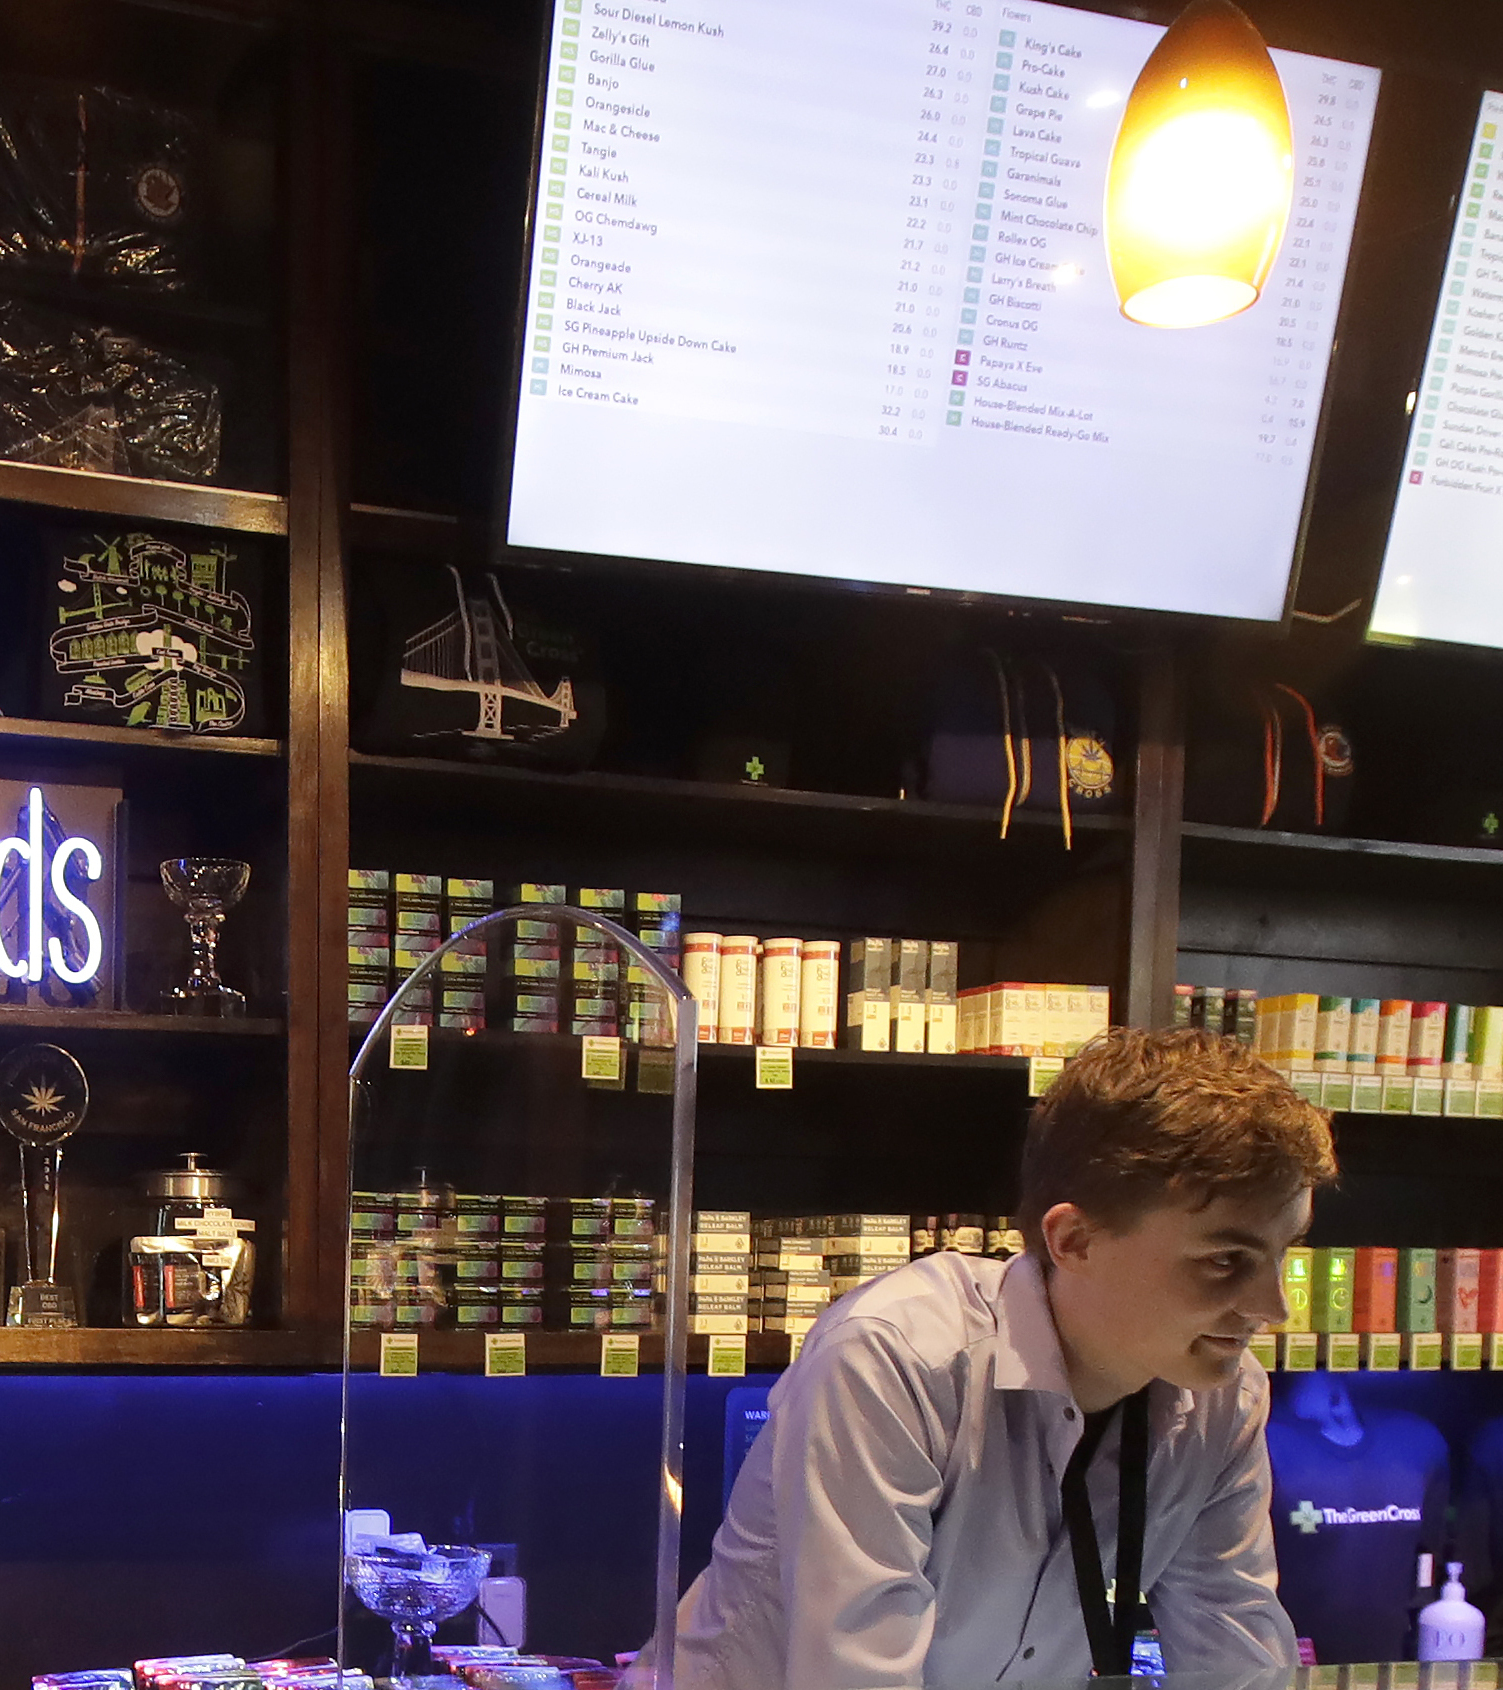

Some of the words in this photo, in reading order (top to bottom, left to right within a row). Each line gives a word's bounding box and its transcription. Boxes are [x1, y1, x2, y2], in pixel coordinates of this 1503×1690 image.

[594, 4, 619, 20] Sour
[623, 8, 655, 25] Diesel
[659, 15, 694, 32] Lemon
[698, 21, 724, 37] Kush
[630, 32, 650, 49] Gift
[1025, 37, 1055, 54] King's
[1058, 44, 1082, 58] Cake
[590, 50, 625, 67] Gorilla
[630, 56, 655, 72] Glue
[588, 74, 619, 90] Banjo
[1019, 82, 1042, 97] Kush
[1046, 87, 1069, 100] Cake
[583, 120, 606, 136] Mac
[609, 124, 618, 135] &
[621, 126, 660, 143] Cheese
[582, 142, 617, 160] Tangie
[579, 165, 600, 180] Kali
[604, 169, 629, 184] Kush
[577, 188, 611, 205] Cereal
[614, 193, 638, 207] Milk
[575, 211, 593, 223] OG
[596, 213, 658, 236] Chemdawg
[1001, 210, 1023, 224] Mint
[1026, 214, 1073, 232] Chocolate
[1076, 222, 1098, 237] Chip
[1030, 237, 1046, 248] OG
[570, 255, 632, 276] Orangeade
[569, 278, 604, 295] Cherry
[607, 282, 623, 295] AK
[567, 299, 594, 313] Black
[598, 302, 621, 316] Jack
[582, 323, 635, 343] Pineapple
[639, 330, 675, 348] Upside
[678, 335, 709, 350] Down
[711, 339, 737, 353] Cake
[563, 343, 579, 355] GH
[582, 345, 627, 361] Premium
[631, 350, 654, 364] Jack
[560, 365, 602, 379] Mimosa
[558, 386, 573, 397] Ice
[576, 388, 609, 402] Cream
[613, 393, 638, 405] Cake
[1322, 1505, 1421, 1524] TheGreenCross
